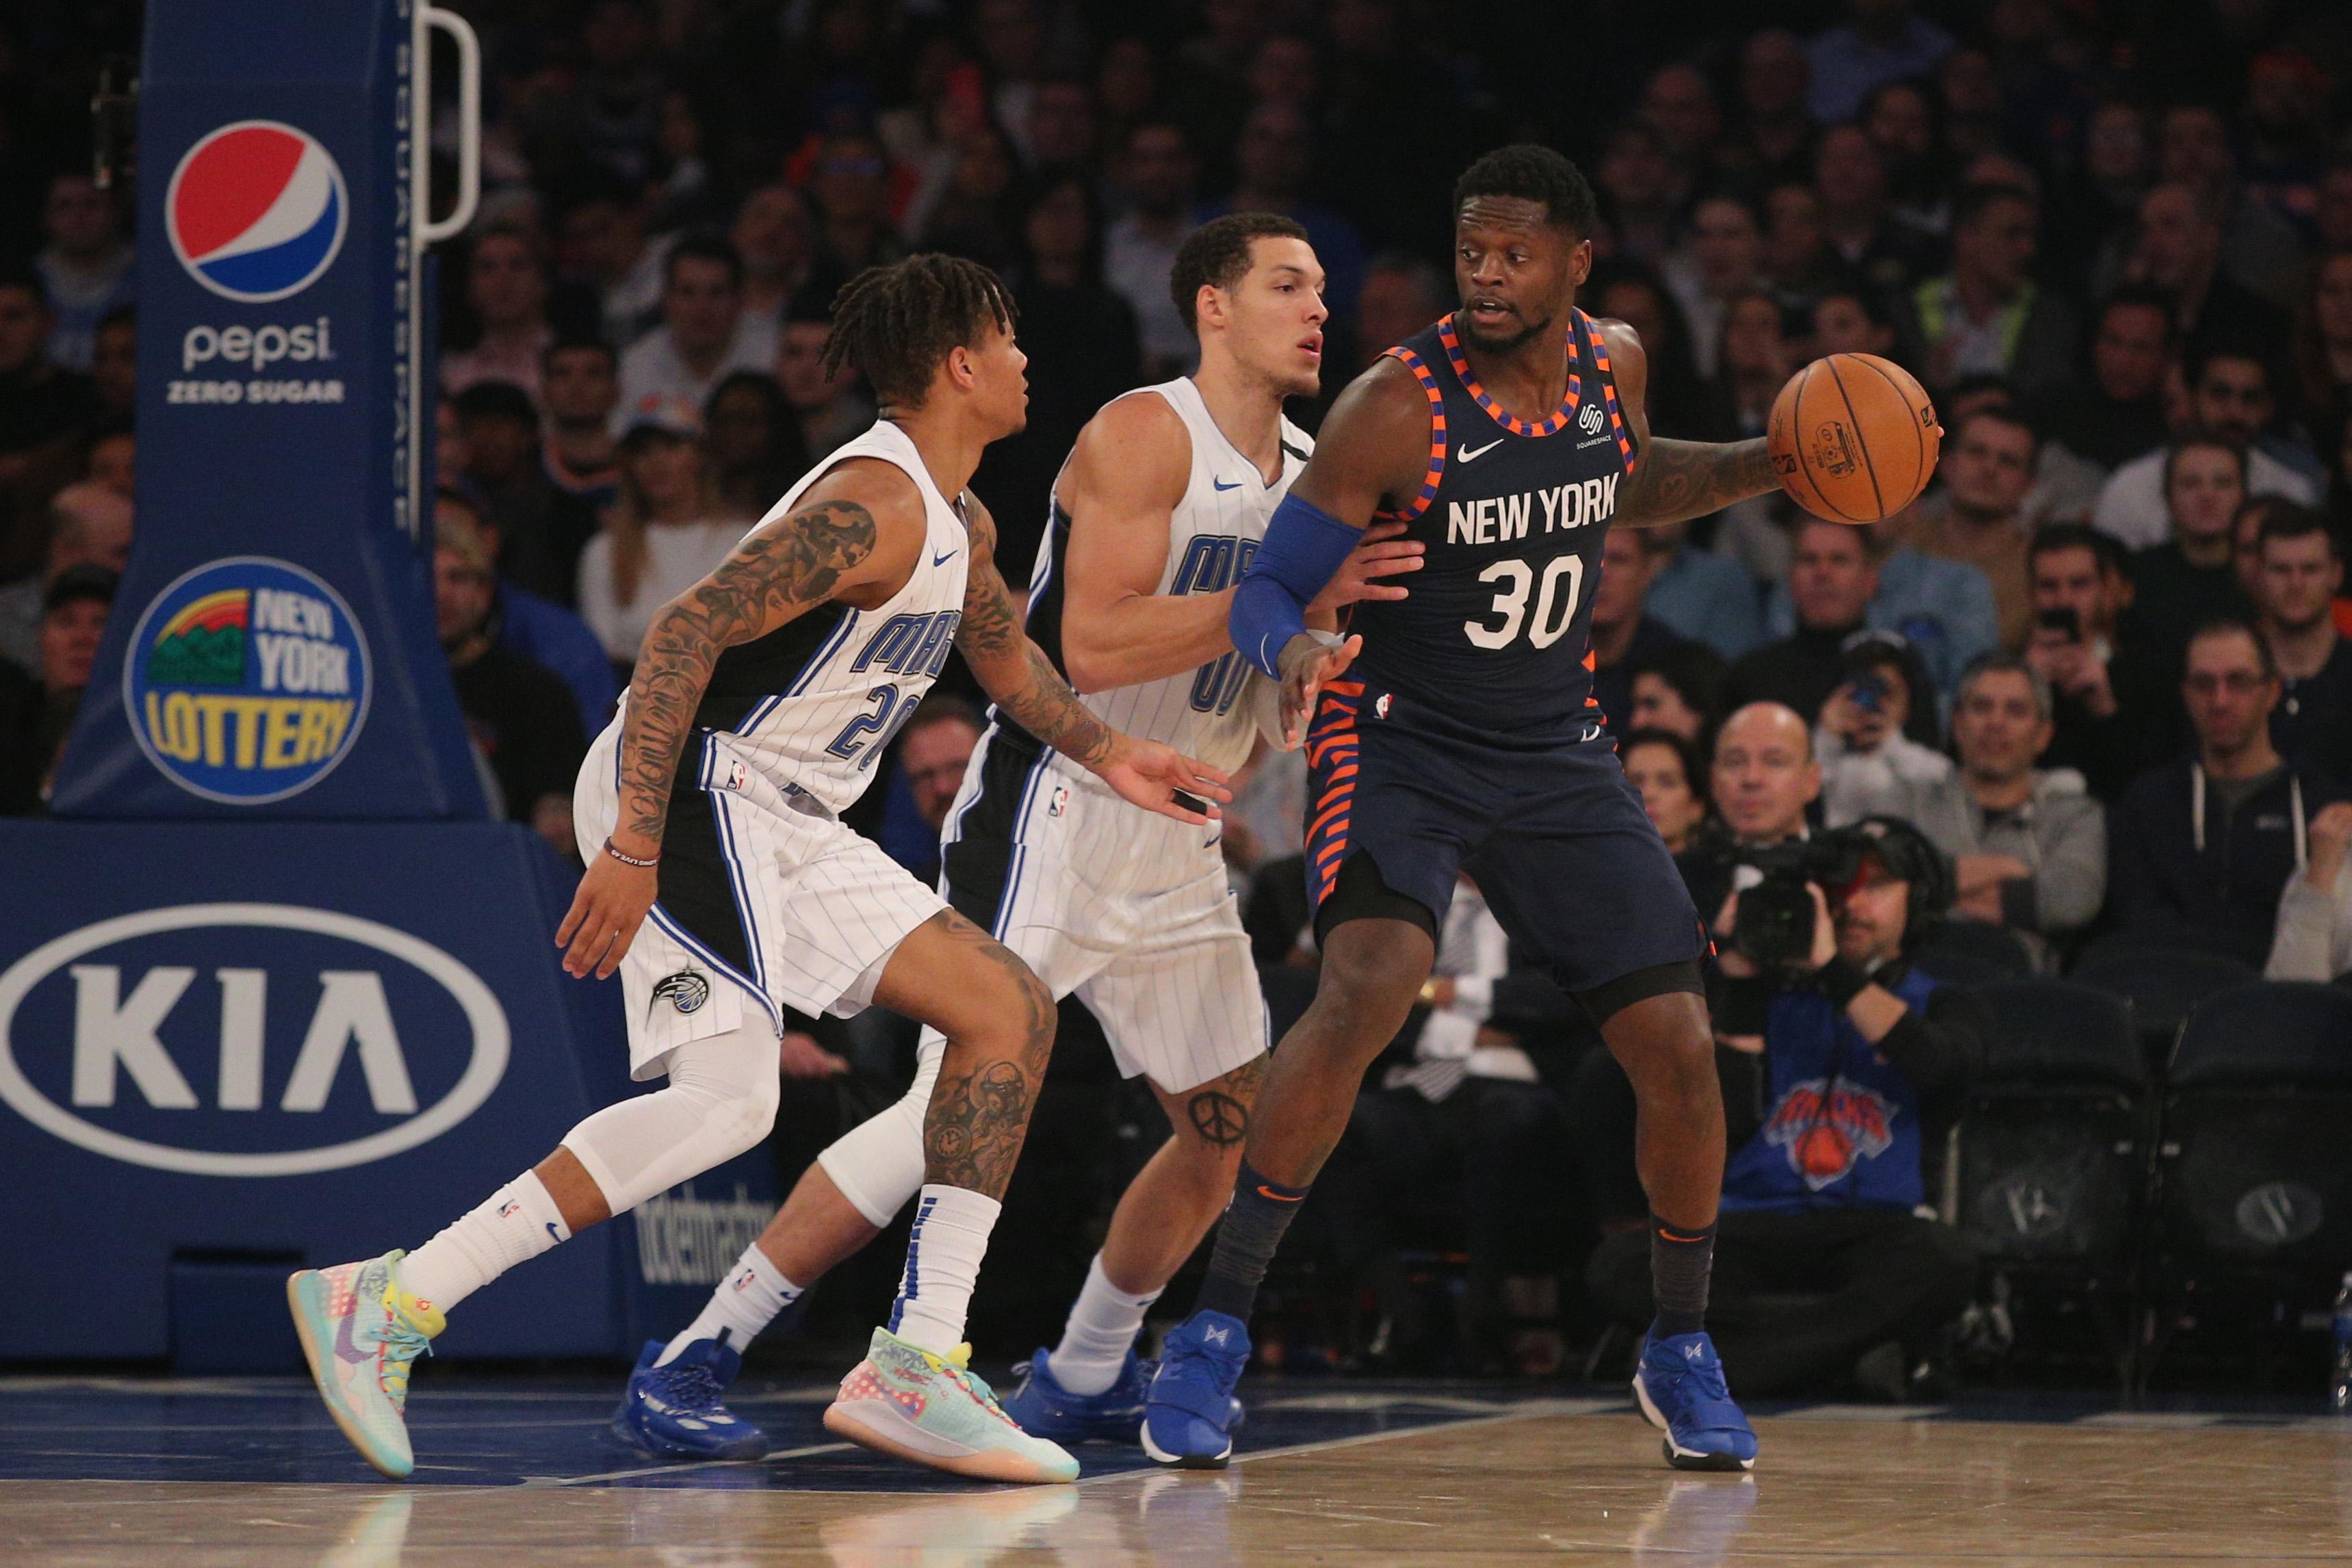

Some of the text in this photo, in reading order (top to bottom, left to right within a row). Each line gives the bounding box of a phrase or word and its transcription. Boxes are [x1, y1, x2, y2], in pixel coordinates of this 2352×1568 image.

[182, 315, 331, 371] pepsi
[167, 380, 344, 404] ZERO SUGAR
[1576, 434, 1612, 450] SQUARESPACE
[1447, 471, 1620, 545] NEW YORK
[254, 588, 334, 638] NEW
[1463, 553, 1584, 651] 30
[255, 633, 350, 696] YORK
[144, 690, 356, 770] LOTTERY
[69, 963, 419, 1114] KIA
